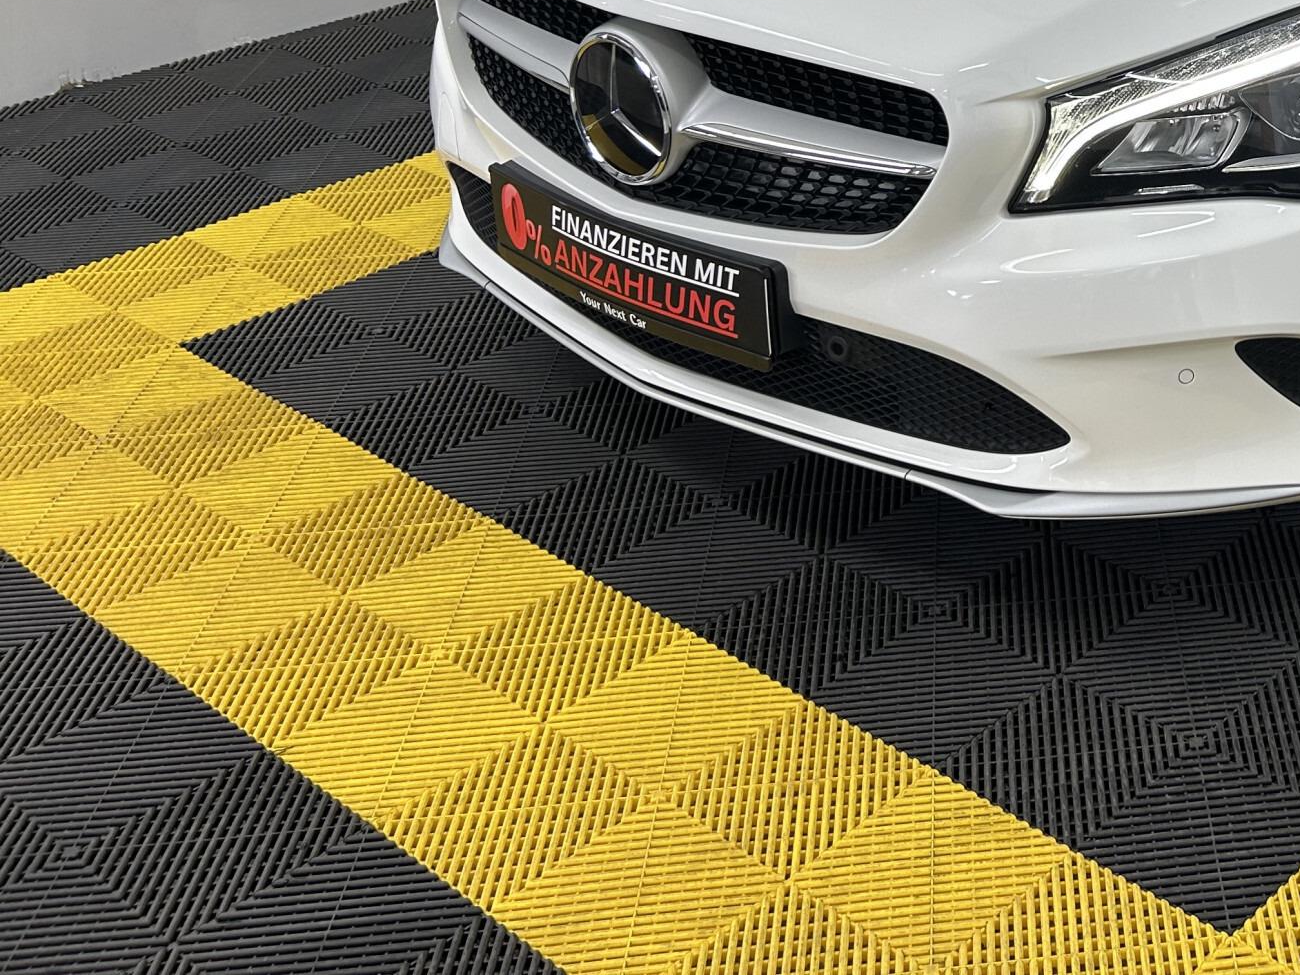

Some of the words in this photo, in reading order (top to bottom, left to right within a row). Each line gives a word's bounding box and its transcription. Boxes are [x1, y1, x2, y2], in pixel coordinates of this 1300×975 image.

[501, 183, 551, 265] 0%
[552, 205, 688, 277] FINANZIEREN
[694, 258, 740, 291] MIT
[555, 239, 736, 331] ANZAHLUNG
[580, 291, 601, 310] Your
[603, 302, 627, 322] Next
[629, 313, 647, 329] Car
